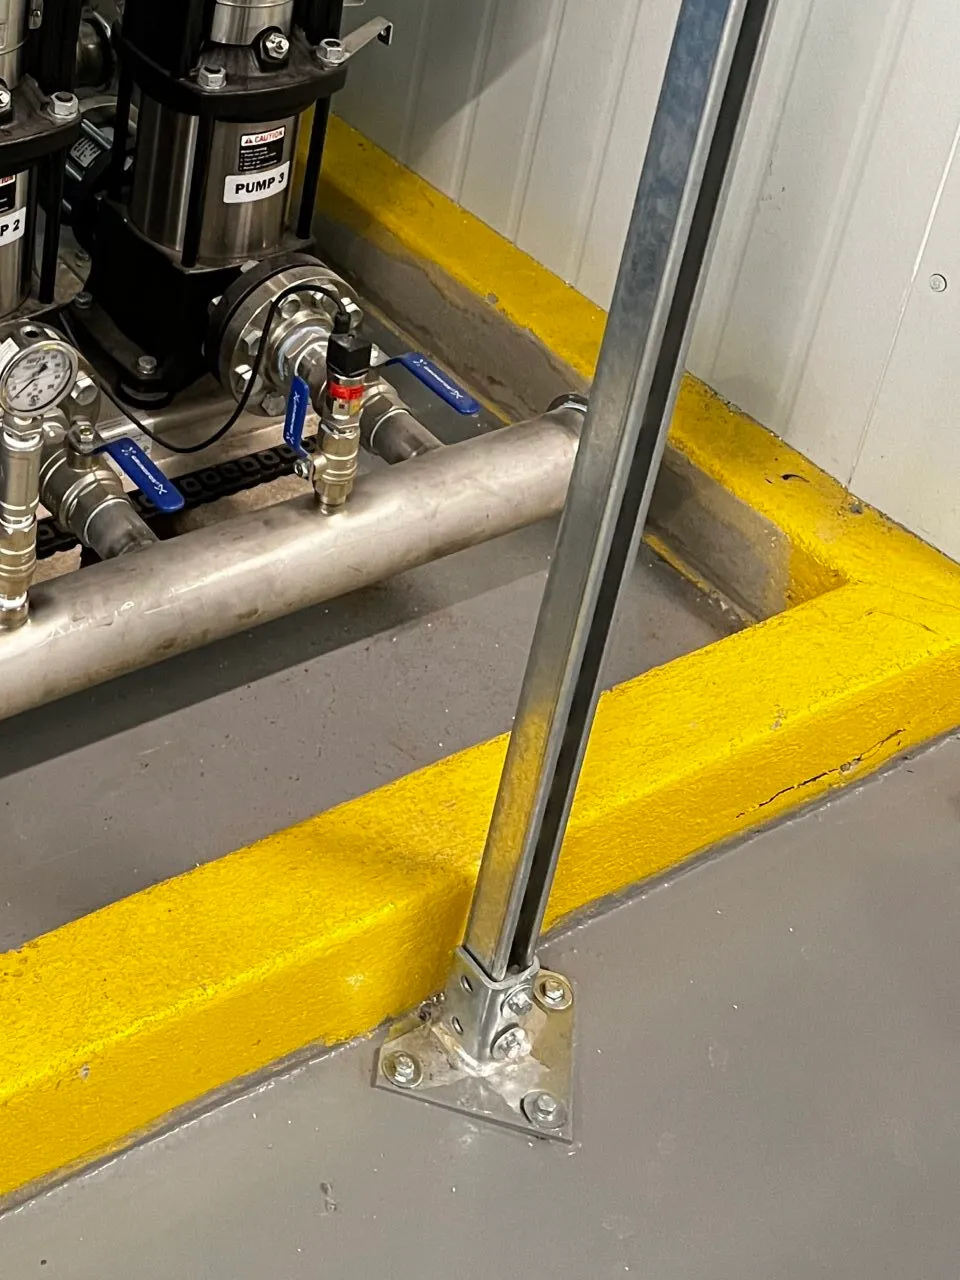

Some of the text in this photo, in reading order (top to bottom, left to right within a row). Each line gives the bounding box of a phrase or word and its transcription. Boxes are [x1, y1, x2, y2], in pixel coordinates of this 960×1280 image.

[254, 130, 283, 143] CAUTION
[235, 172, 284, 194] PUMP 3
[13, 219, 20, 232] 2
